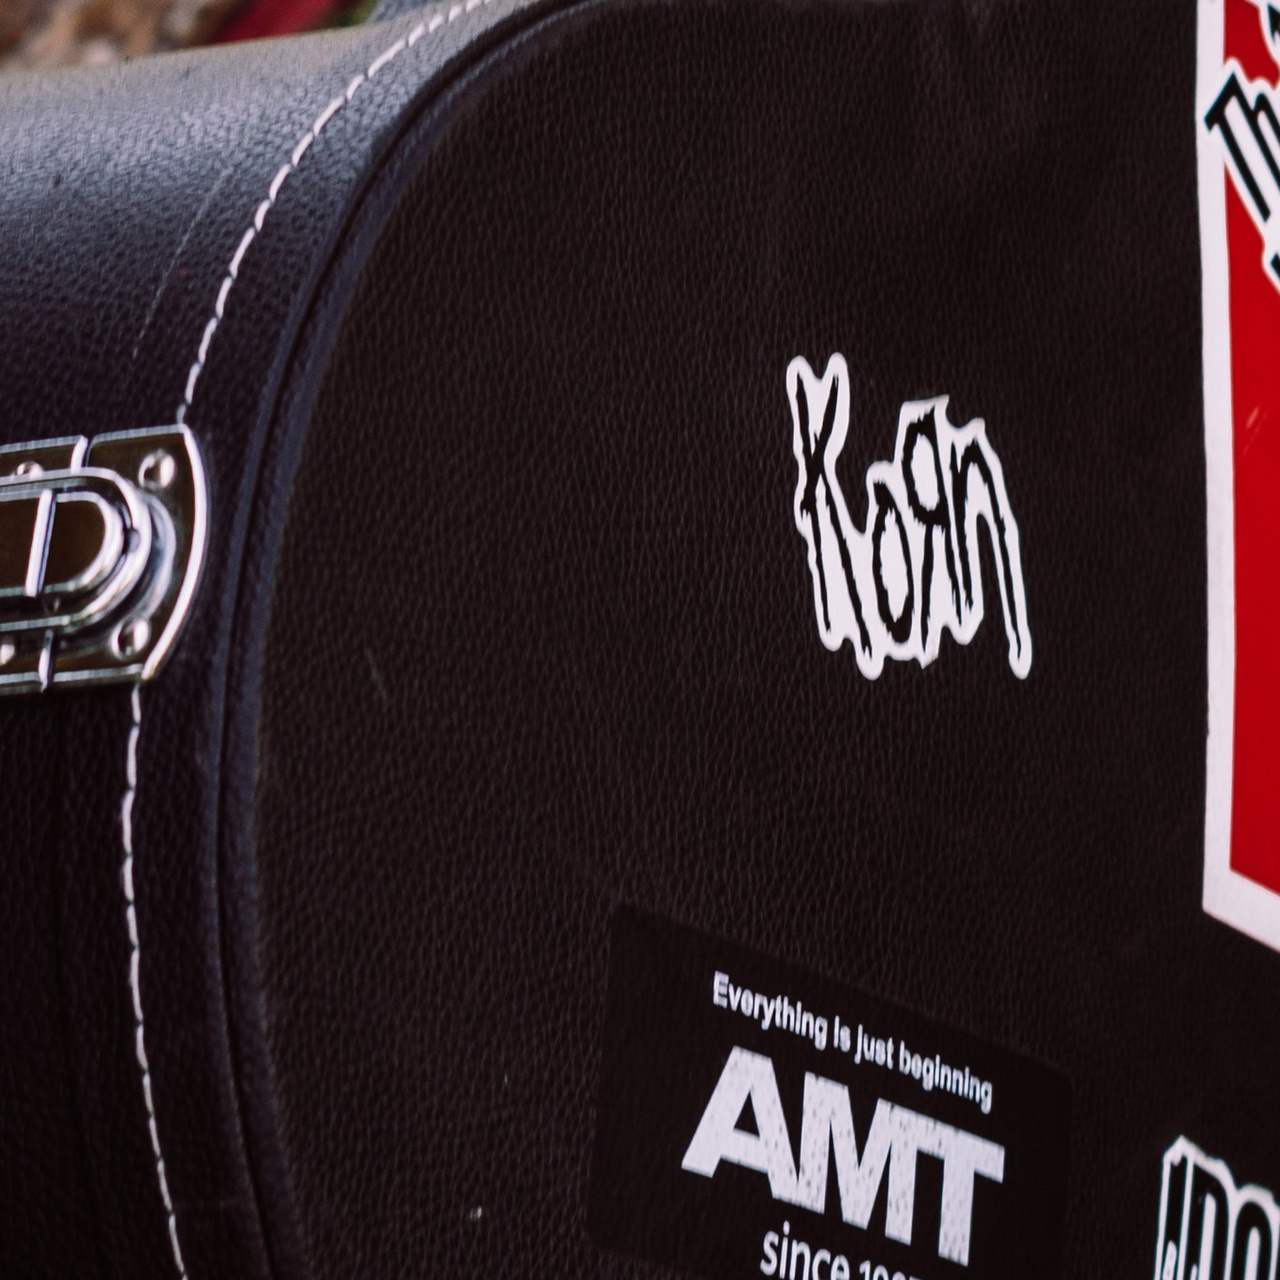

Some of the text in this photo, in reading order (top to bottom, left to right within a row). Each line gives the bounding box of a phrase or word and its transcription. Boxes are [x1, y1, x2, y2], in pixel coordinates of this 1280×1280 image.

[713, 970, 993, 1114] Everything is just beginning
[681, 1046, 1005, 1267] AMT
